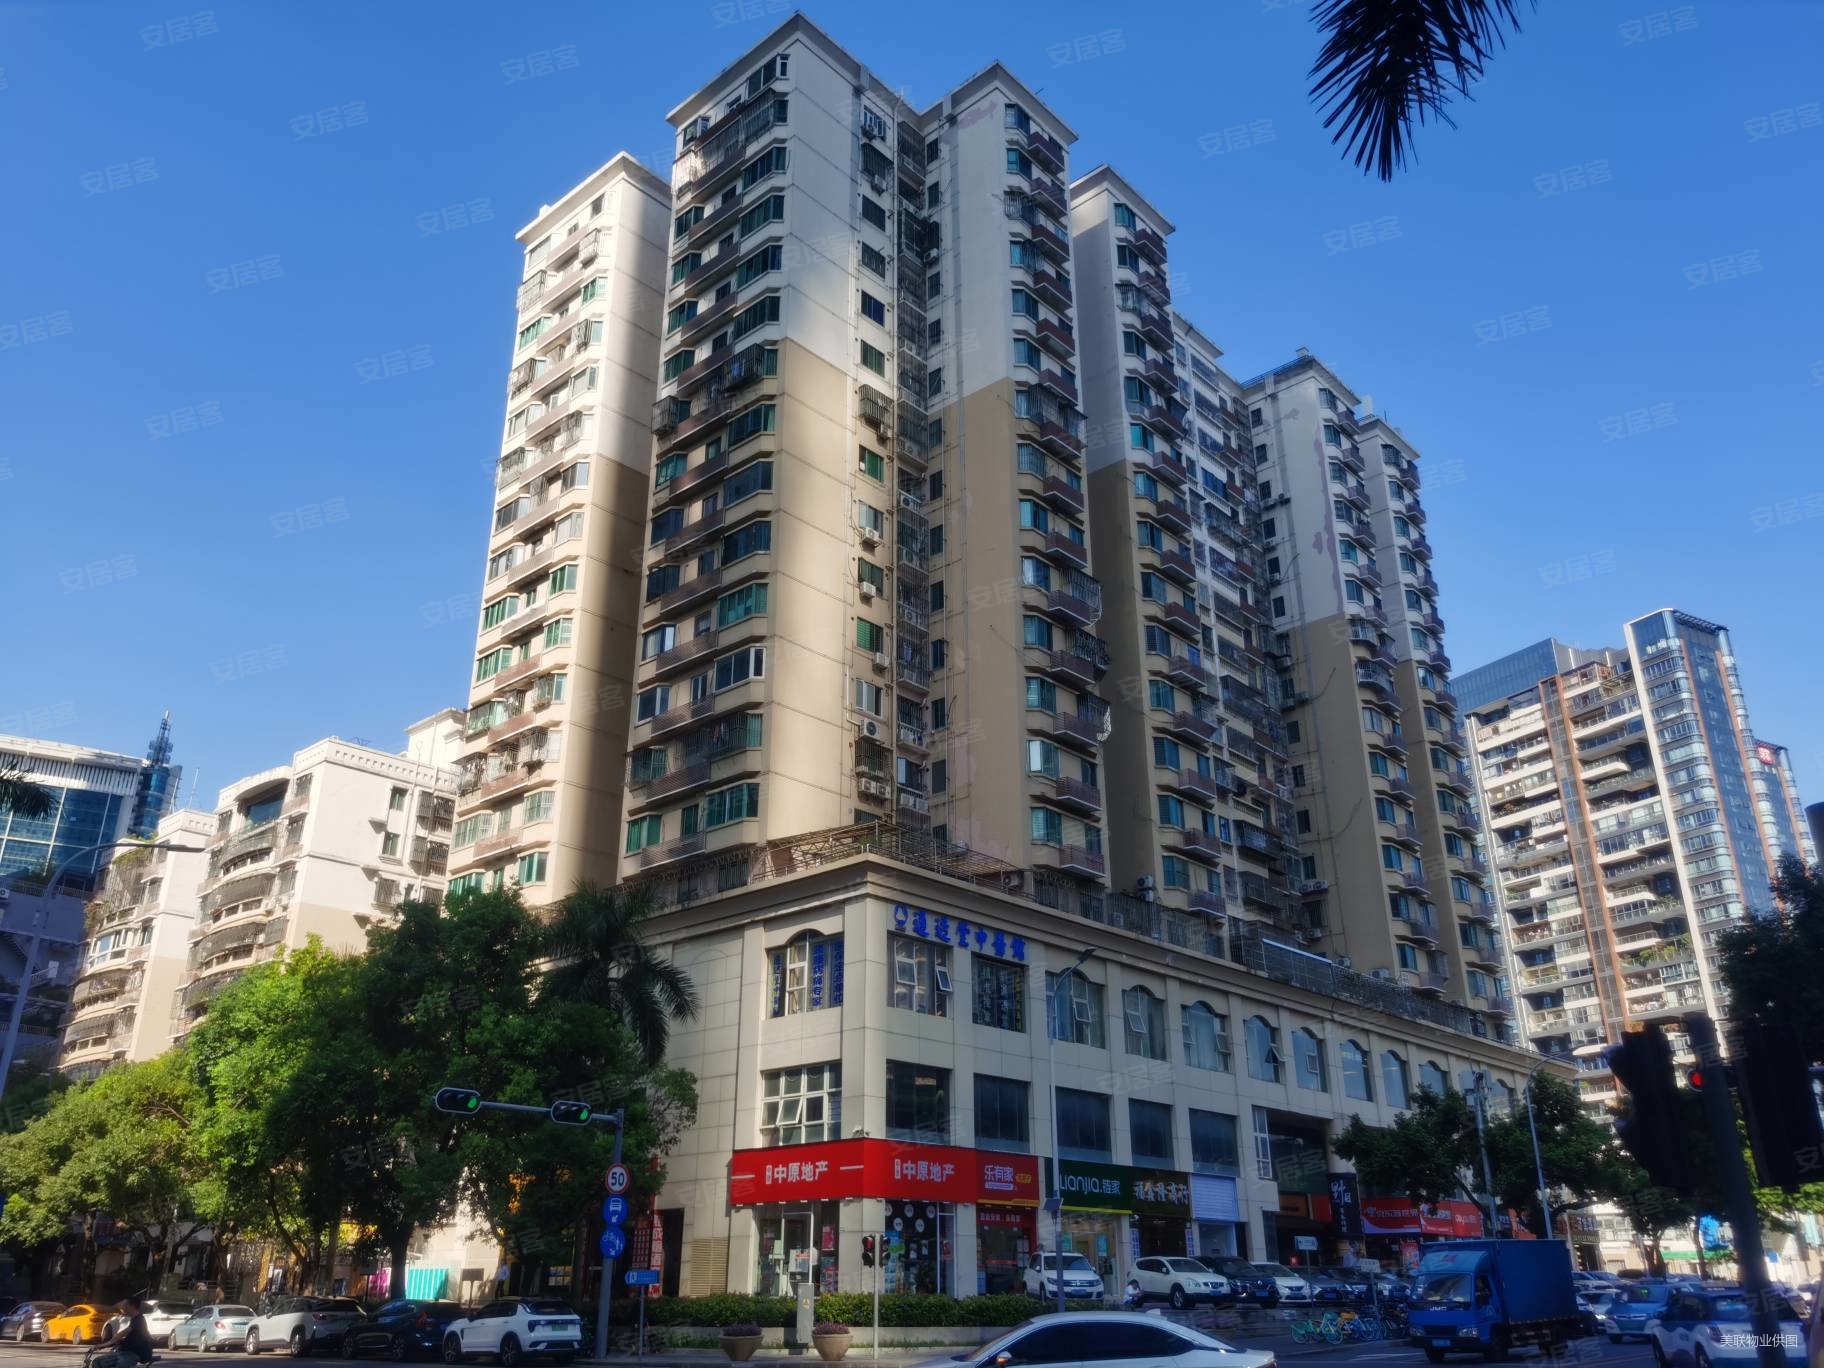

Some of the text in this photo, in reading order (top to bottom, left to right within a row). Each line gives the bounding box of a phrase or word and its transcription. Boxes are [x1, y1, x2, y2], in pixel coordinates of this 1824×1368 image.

[611, 1172, 625, 1186] 50
[774, 1161, 828, 1184] 中原地产
[903, 1161, 955, 1182] 中原地产
[984, 1165, 1014, 1182] 乐有家
